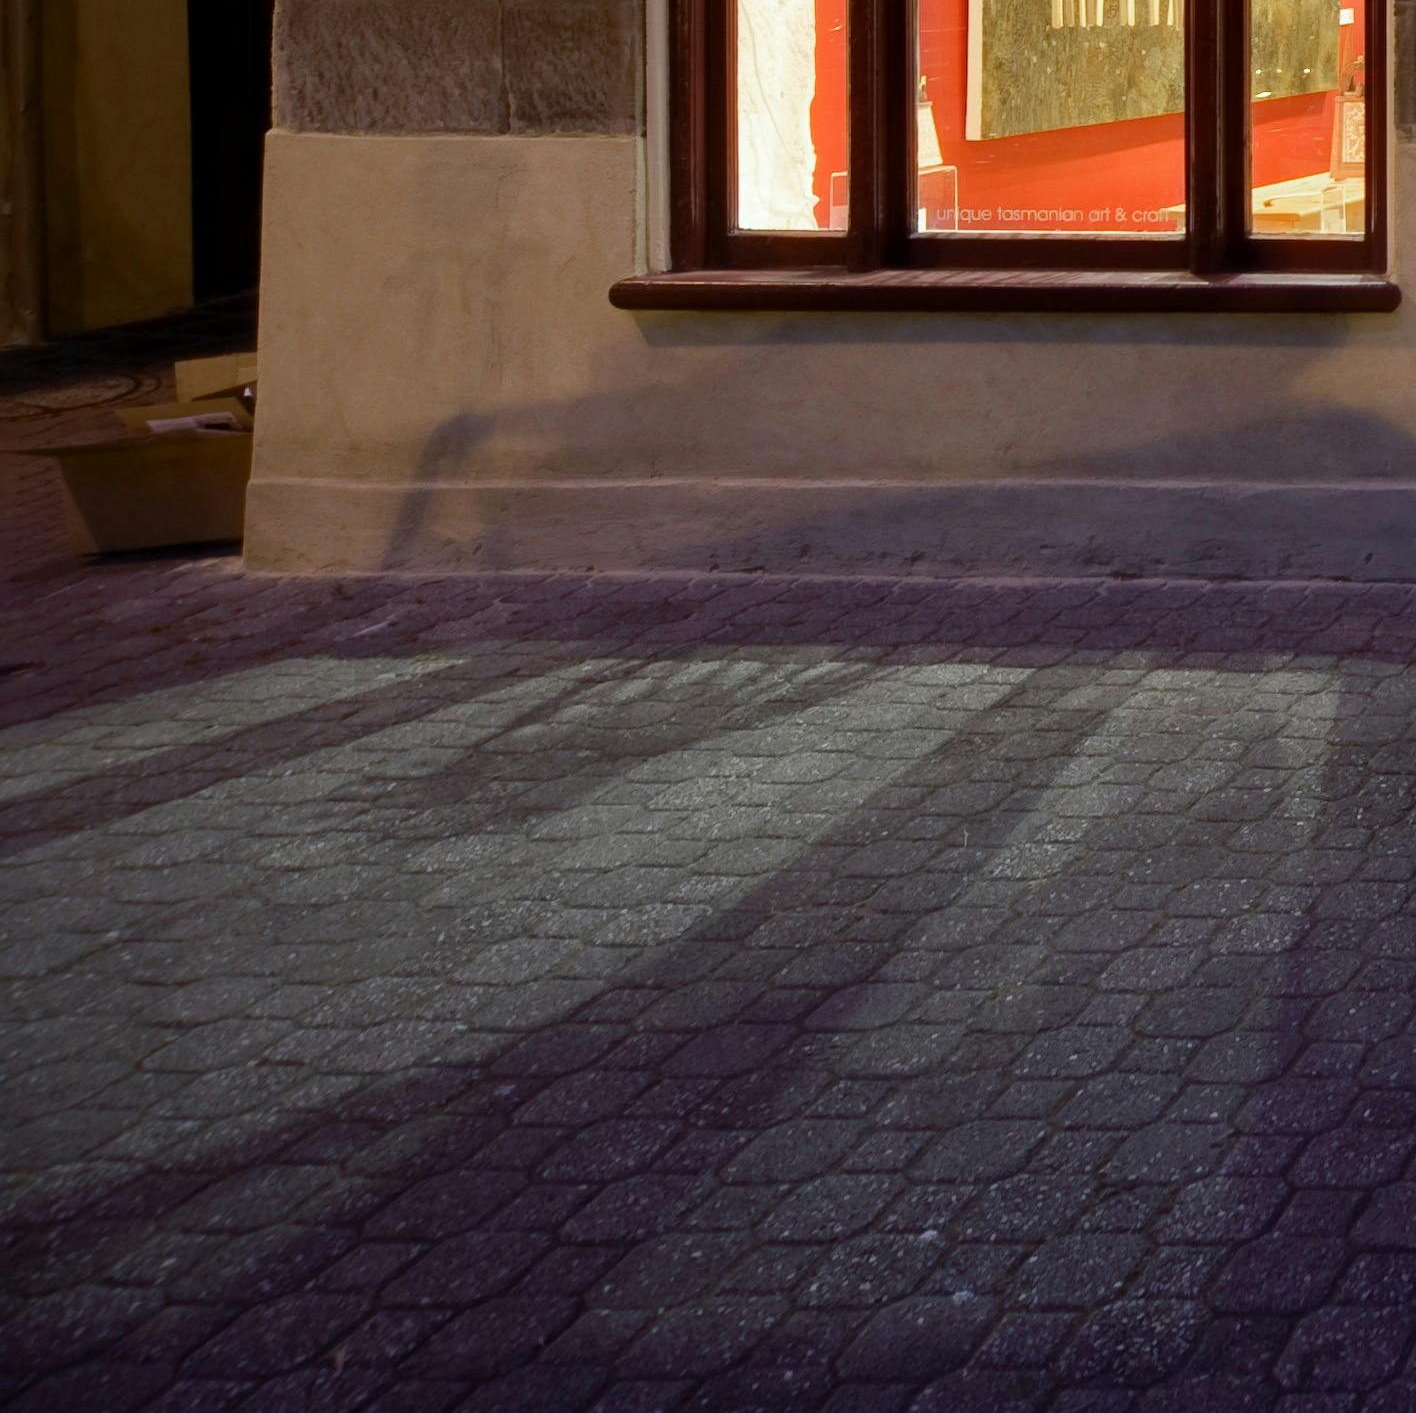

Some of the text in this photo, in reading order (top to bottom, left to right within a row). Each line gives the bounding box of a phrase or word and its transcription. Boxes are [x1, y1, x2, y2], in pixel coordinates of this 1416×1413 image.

[937, 206, 992, 224] unique
[996, 205, 1084, 223] tasmanian
[1088, 207, 1110, 223] art
[1114, 207, 1127, 223] &
